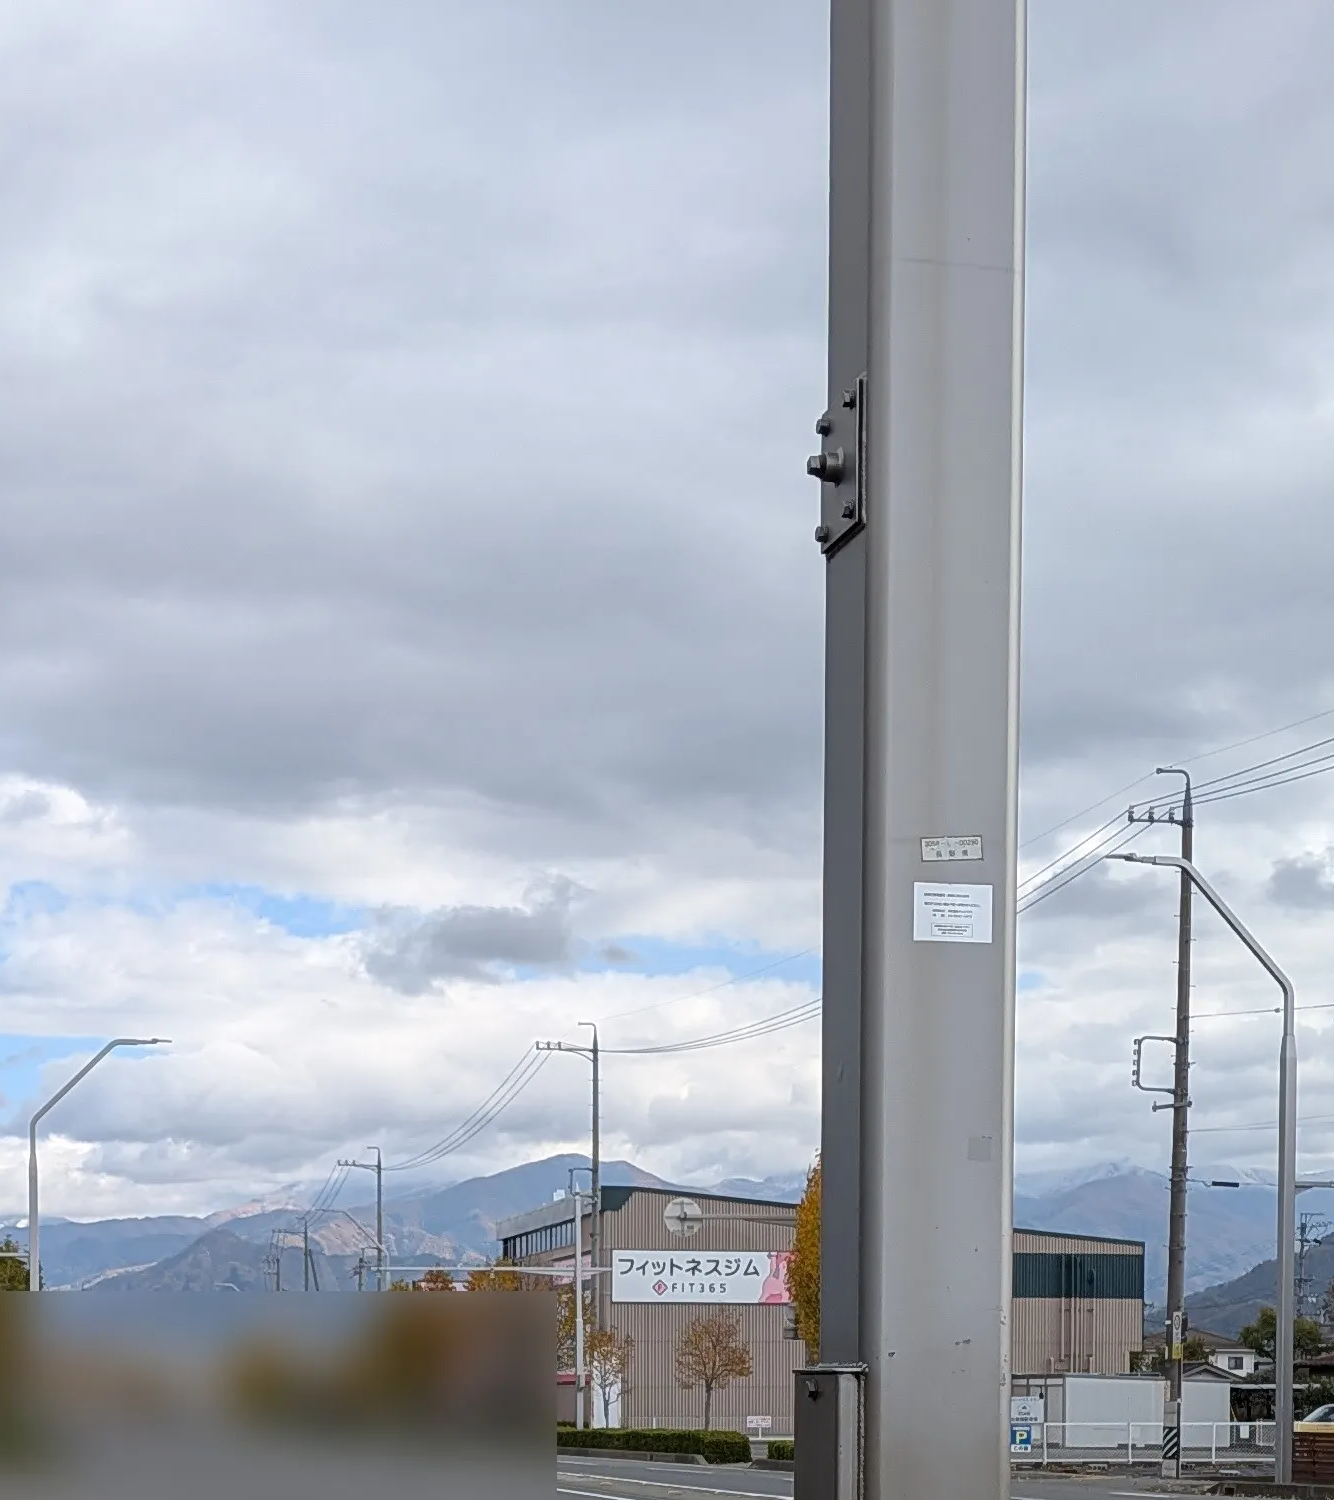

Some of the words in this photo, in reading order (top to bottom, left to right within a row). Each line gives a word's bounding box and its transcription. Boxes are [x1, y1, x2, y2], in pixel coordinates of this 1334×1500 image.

[618, 1258, 760, 1276] フィットネスジム
[671, 1283, 727, 1293] FIT365
[1016, 1431, 1028, 1445] P
